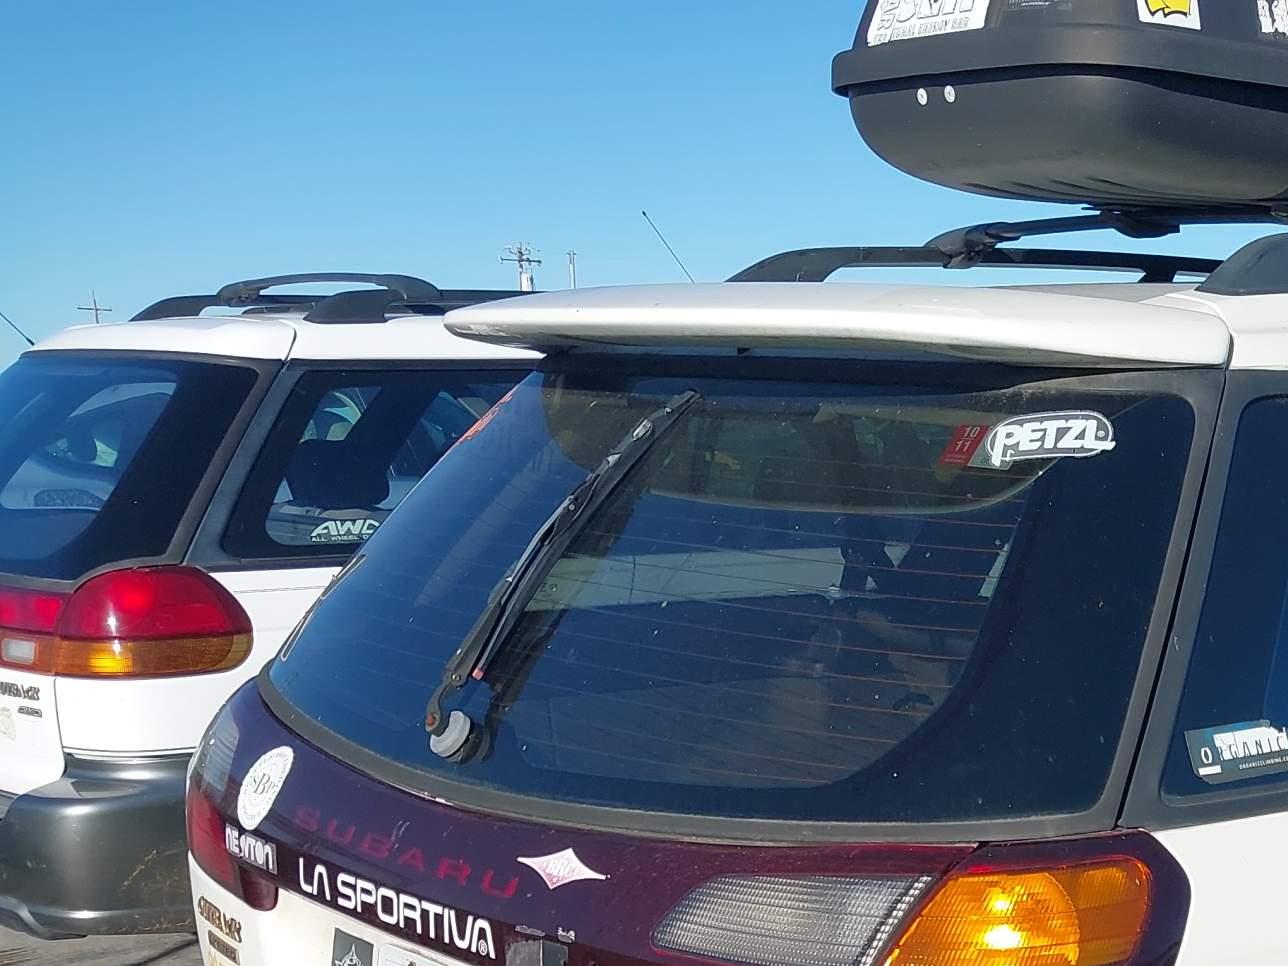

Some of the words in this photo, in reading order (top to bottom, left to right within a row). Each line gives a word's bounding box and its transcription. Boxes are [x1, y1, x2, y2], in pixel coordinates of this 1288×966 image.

[954, 440, 972, 452] 11
[963, 425, 981, 438] 10
[992, 419, 1116, 466] PETZL
[293, 807, 520, 899] SUBARU
[298, 857, 331, 901] LA
[336, 872, 496, 960] SPORTIVA
